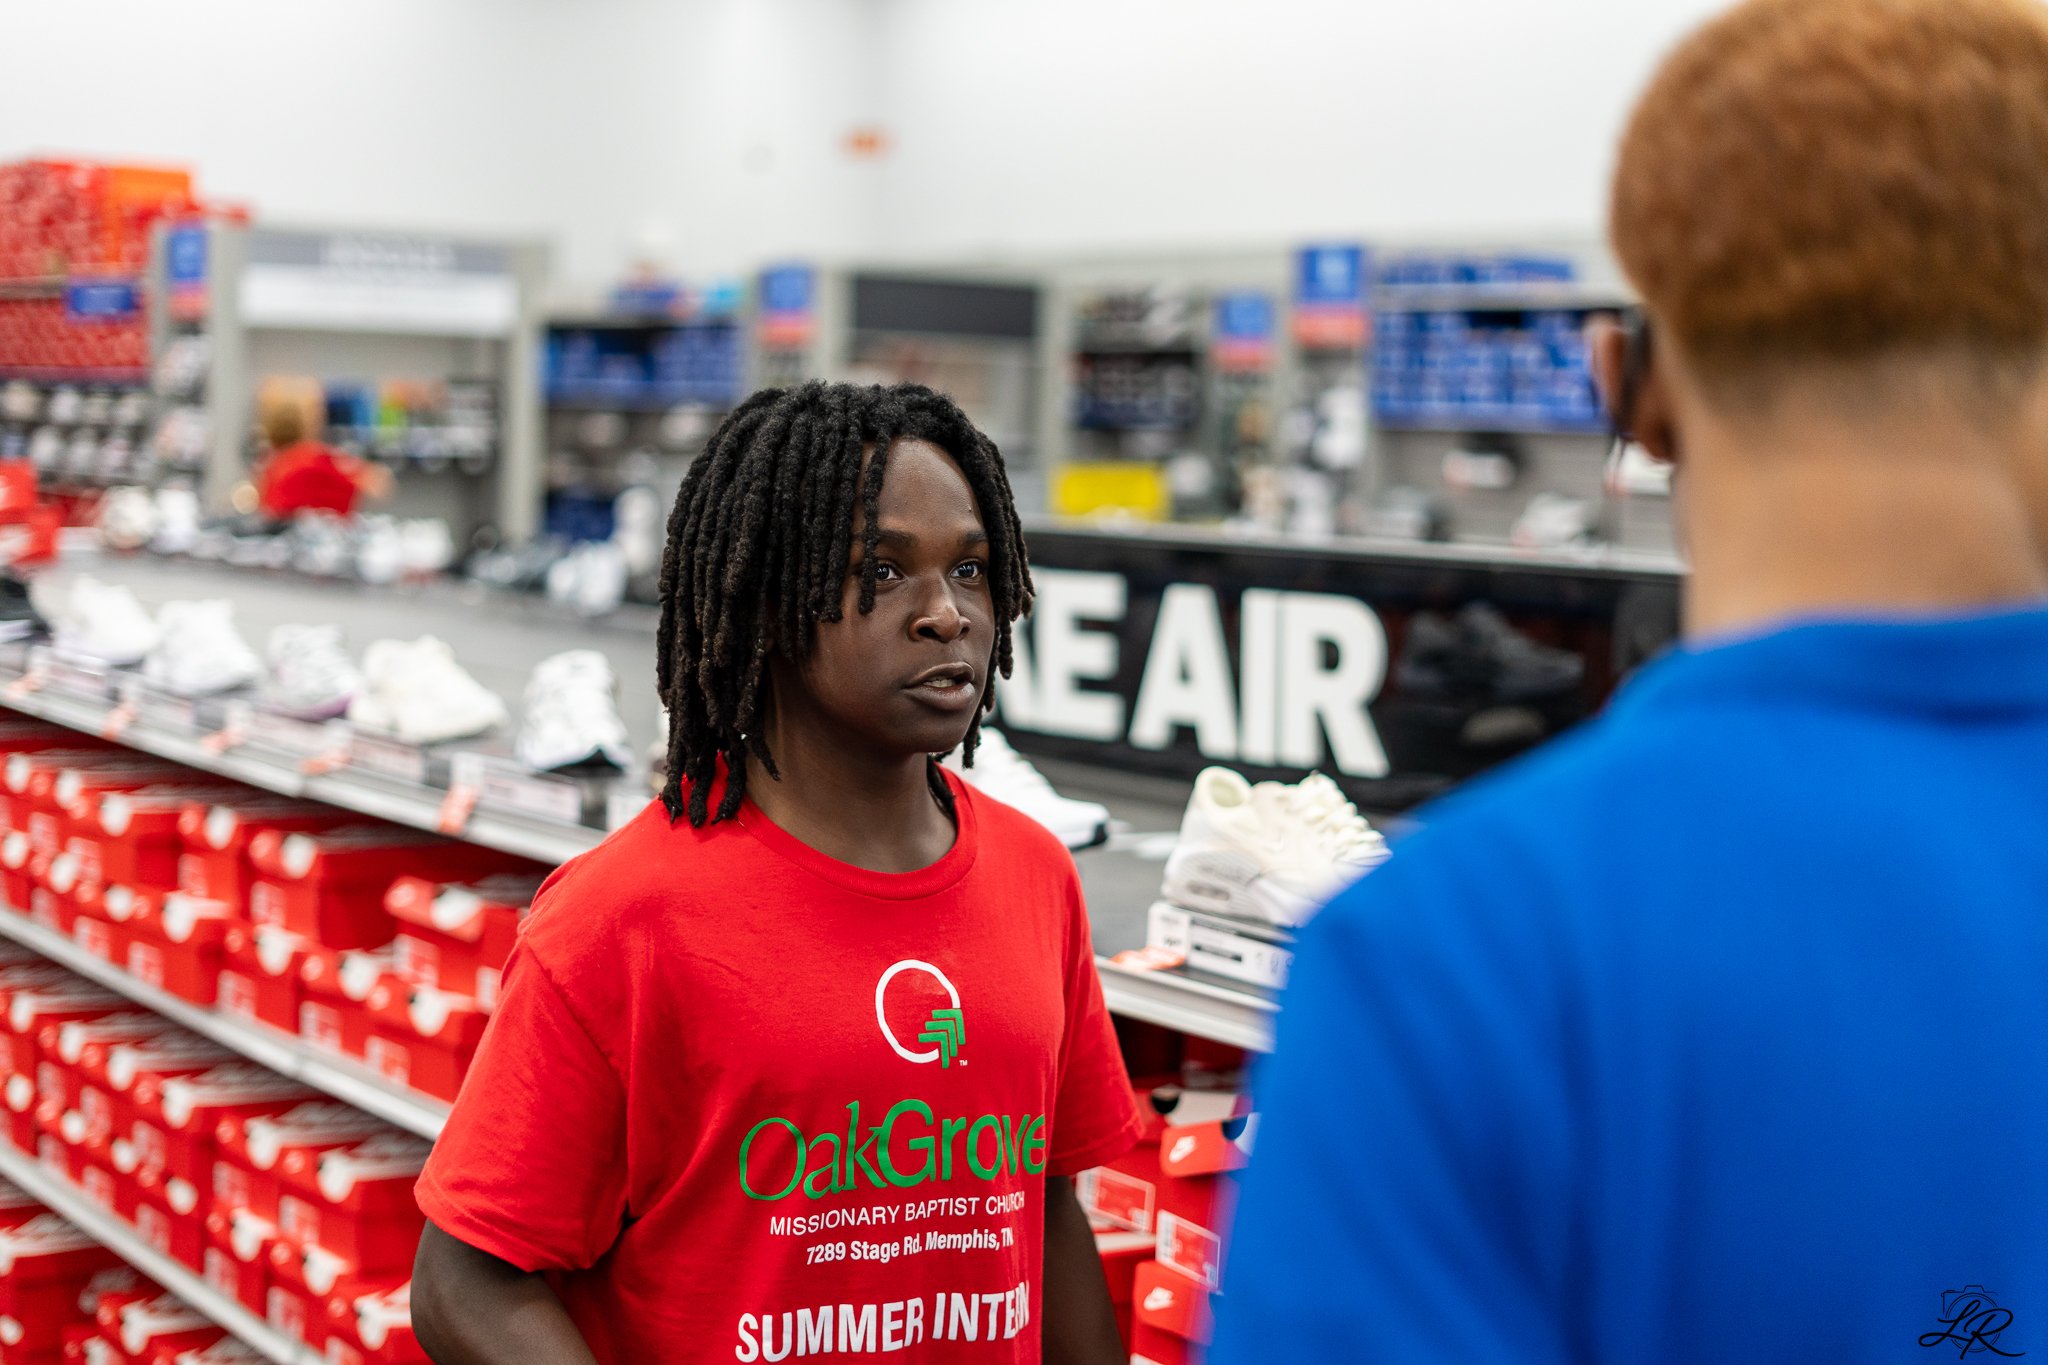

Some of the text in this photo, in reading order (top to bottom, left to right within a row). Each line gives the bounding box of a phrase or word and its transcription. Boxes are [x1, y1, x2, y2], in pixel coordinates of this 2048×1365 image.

[1128, 582, 1391, 779] AIR
[739, 1099, 1046, 1200] OakGrove
[769, 1205, 900, 1236] MISSIONARY
[904, 1197, 980, 1222] BAPTIST
[806, 1226, 1014, 1265] 7289 Stage Rd. Memphis, TN
[735, 1297, 925, 1363] SUMMER
